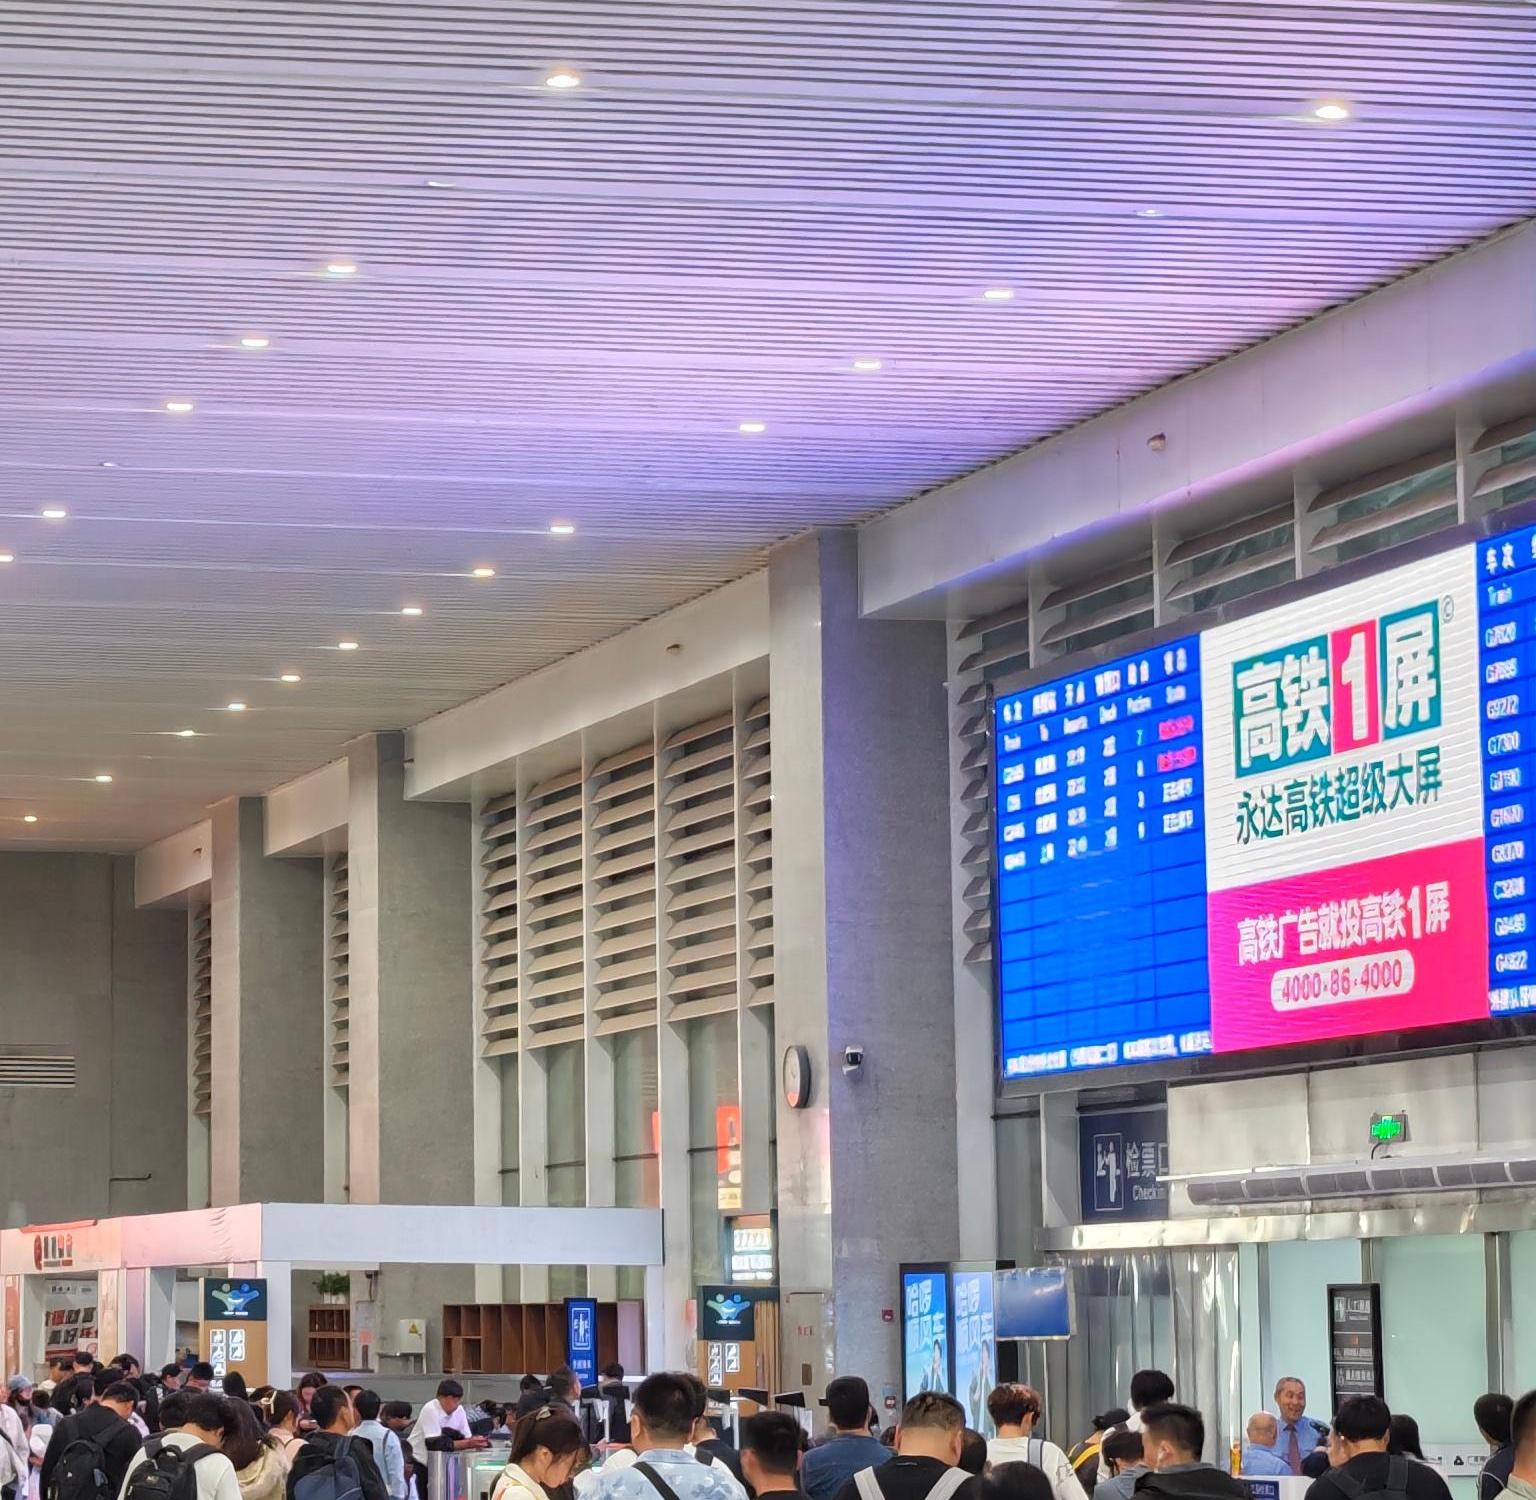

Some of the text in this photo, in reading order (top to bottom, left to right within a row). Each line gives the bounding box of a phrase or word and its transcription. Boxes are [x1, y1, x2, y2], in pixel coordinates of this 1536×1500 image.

[1237, 611, 1437, 768] 高铁1屏
[1236, 746, 1443, 845] 永达高铁超级大屏
[1237, 881, 1451, 966] 高铁广告就投高铁1屏
